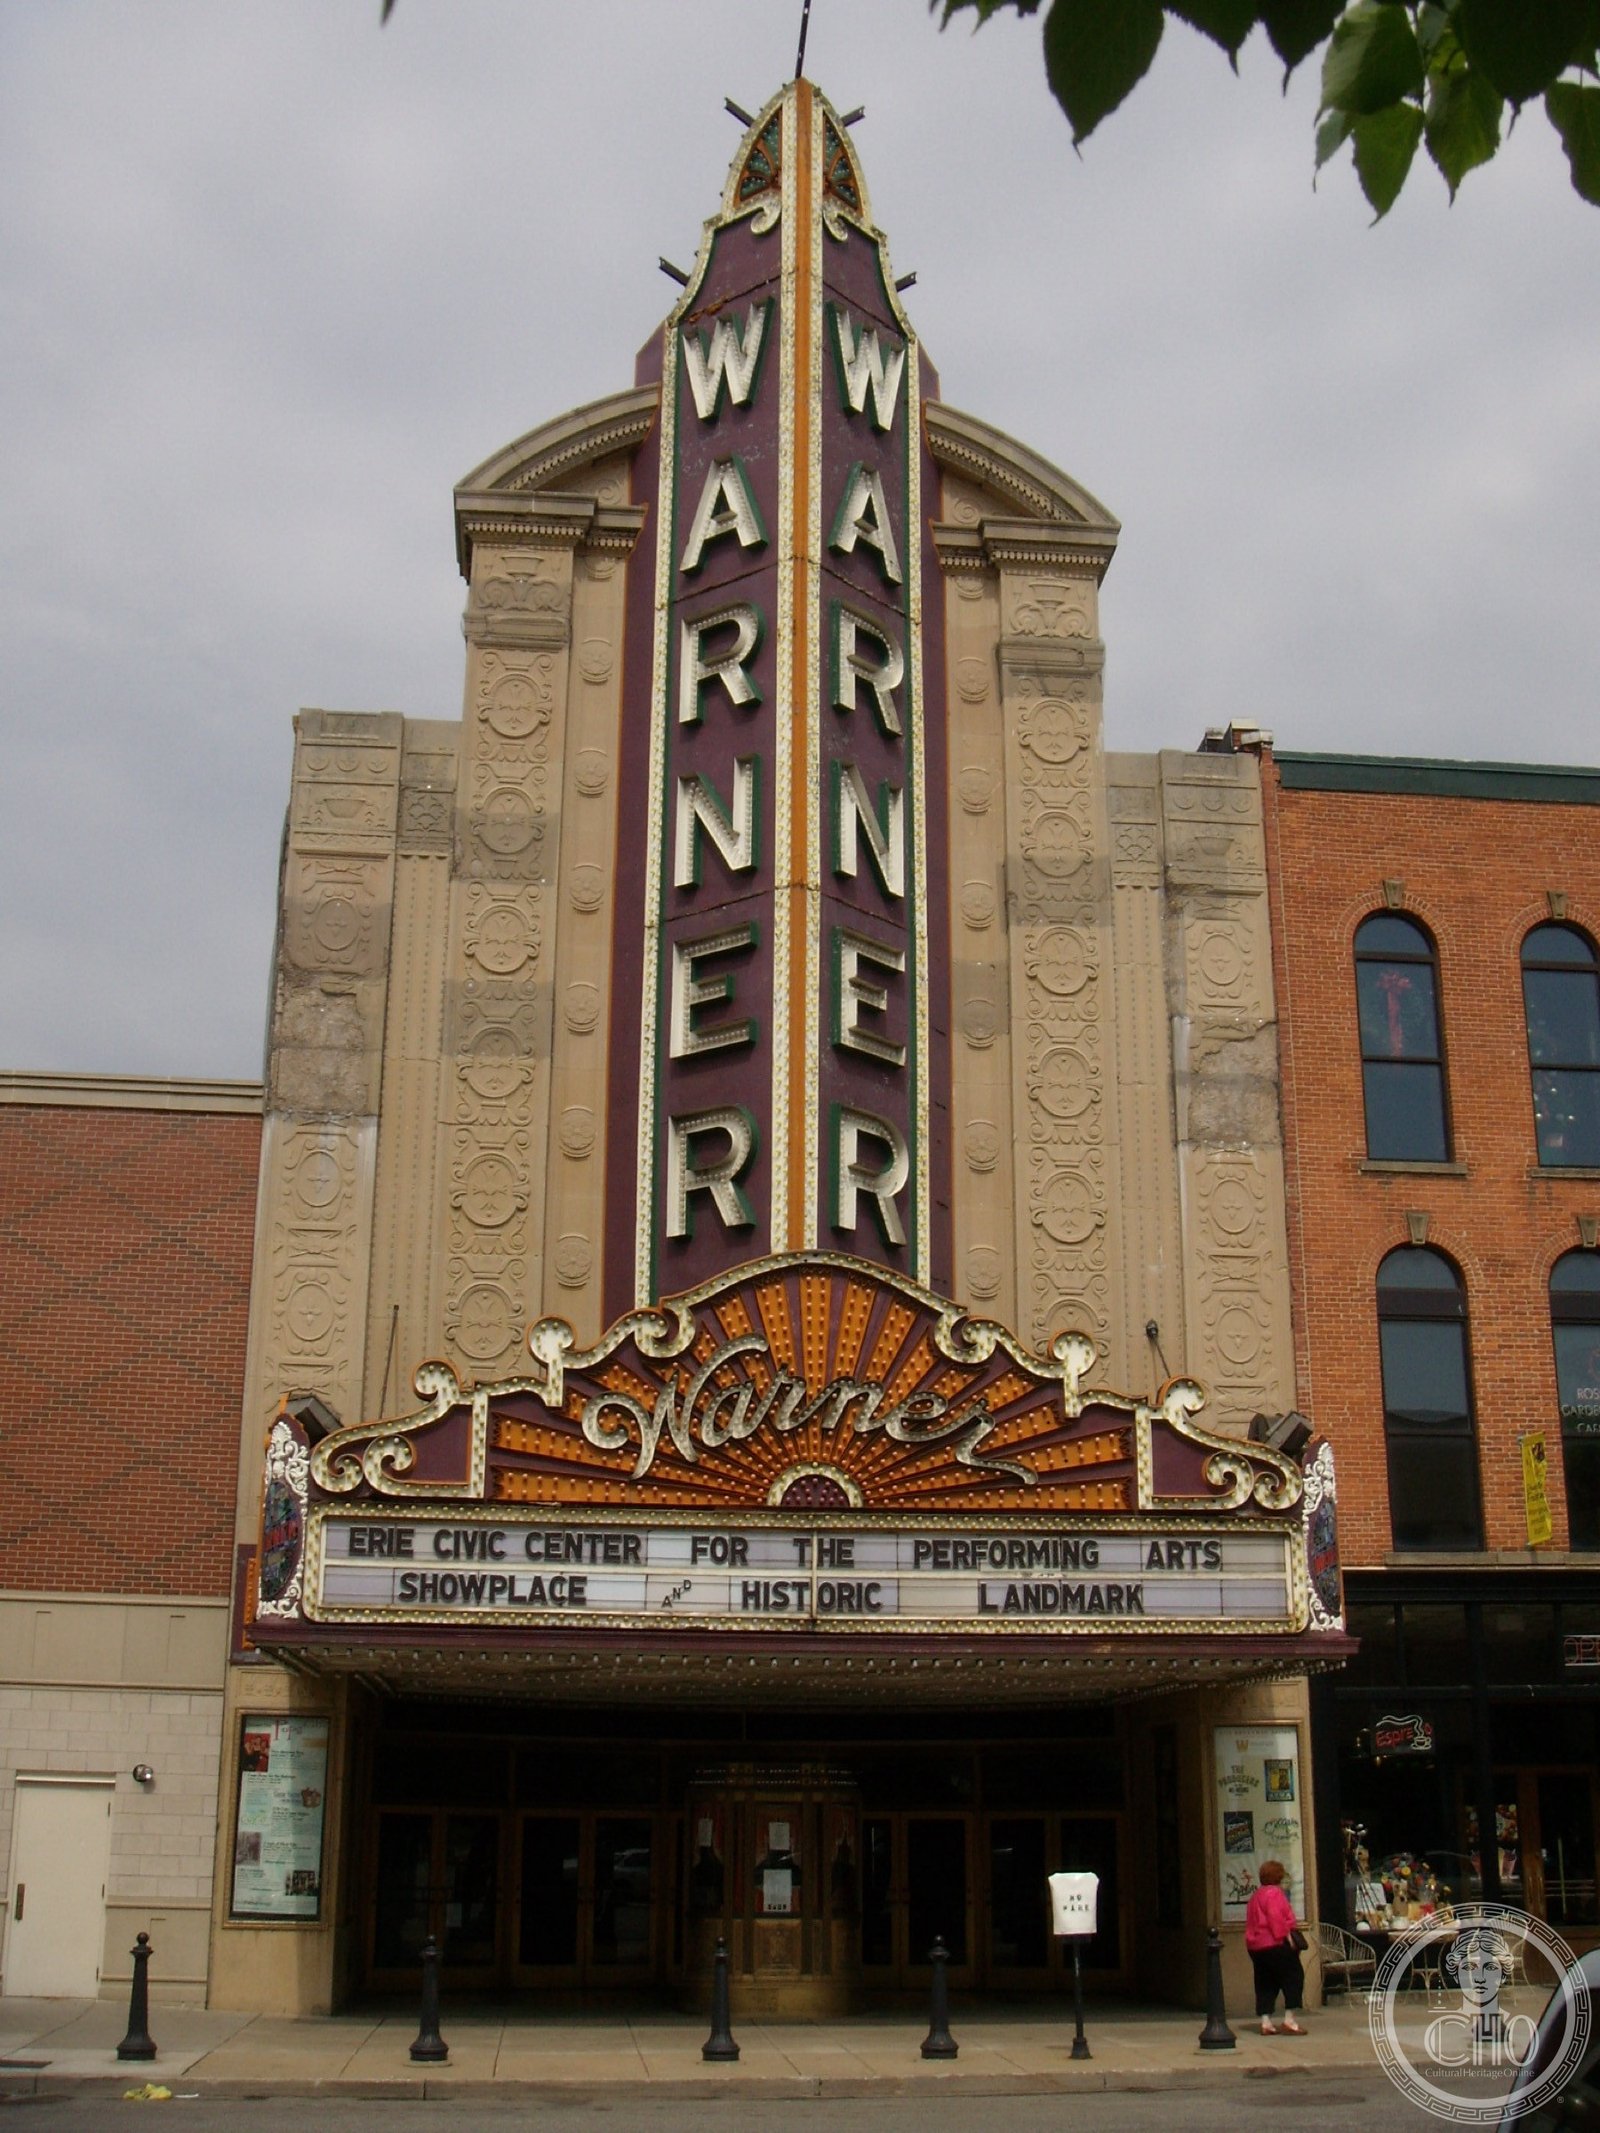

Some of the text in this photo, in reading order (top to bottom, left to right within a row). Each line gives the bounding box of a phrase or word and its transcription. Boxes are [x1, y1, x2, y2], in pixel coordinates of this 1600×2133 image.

[666, 297, 775, 1239] WARNER
[826, 300, 911, 1246] WARNER
[582, 1334, 1039, 1485] Warner
[348, 1526, 1222, 1571] ERIE CIVIC CENTER FOR THE PERFORMING ARTS
[398, 1572, 1145, 1615] SHOWPLACE AND HISTORIC LANDMARK
